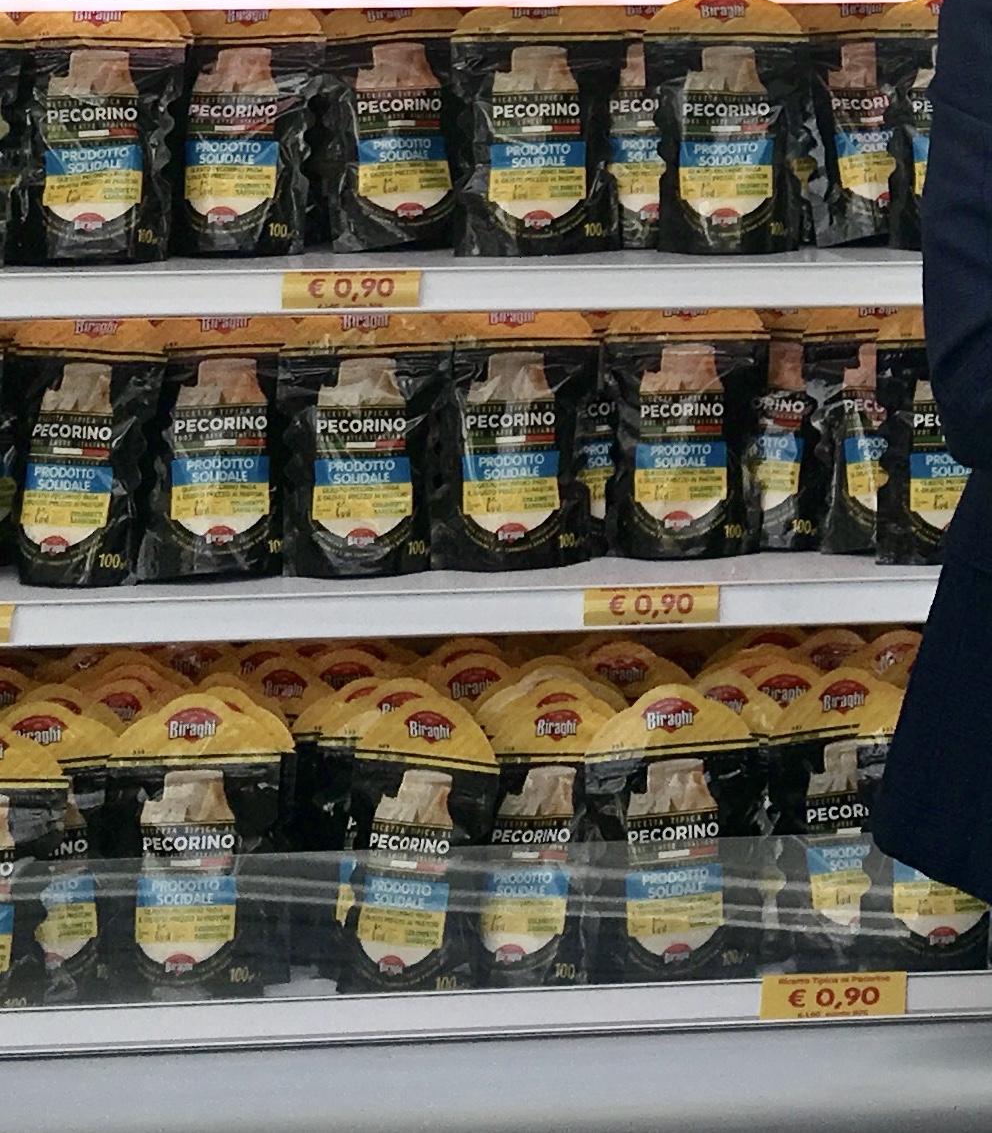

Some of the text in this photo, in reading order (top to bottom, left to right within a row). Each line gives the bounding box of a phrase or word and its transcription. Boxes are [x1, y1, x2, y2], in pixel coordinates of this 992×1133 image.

[189, 103, 278, 118] PECORINO
[357, 97, 442, 114] PECORINO
[493, 103, 580, 119] PECORINO
[682, 103, 770, 116] PECORINO
[47, 107, 138, 123] PECORINO
[506, 143, 571, 156] PRODOTTO
[308, 277, 395, 302] € 0,90
[640, 403, 724, 418] PECORINO
[174, 416, 268, 434] PECORINO
[317, 418, 406, 434] PECORINO
[466, 412, 555, 429] PECORINO
[32, 423, 112, 441] PECORINO
[328, 460, 395, 472] PRODOTTO
[479, 454, 544, 467] PRODOTTO
[609, 594, 694, 619] € 0,90
[822, 689, 865, 711] Biraghi
[536, 718, 577, 737] Biraghi
[646, 708, 694, 730] Biraghi
[169, 719, 217, 738] Biraghi
[409, 720, 451, 740] Biraghi
[492, 828, 570, 843] PECORINO
[628, 822, 719, 844] PECORINO
[143, 834, 235, 851] PECORINO
[370, 832, 450, 854] PECORINO
[788, 986, 880, 1009] € 0,90
